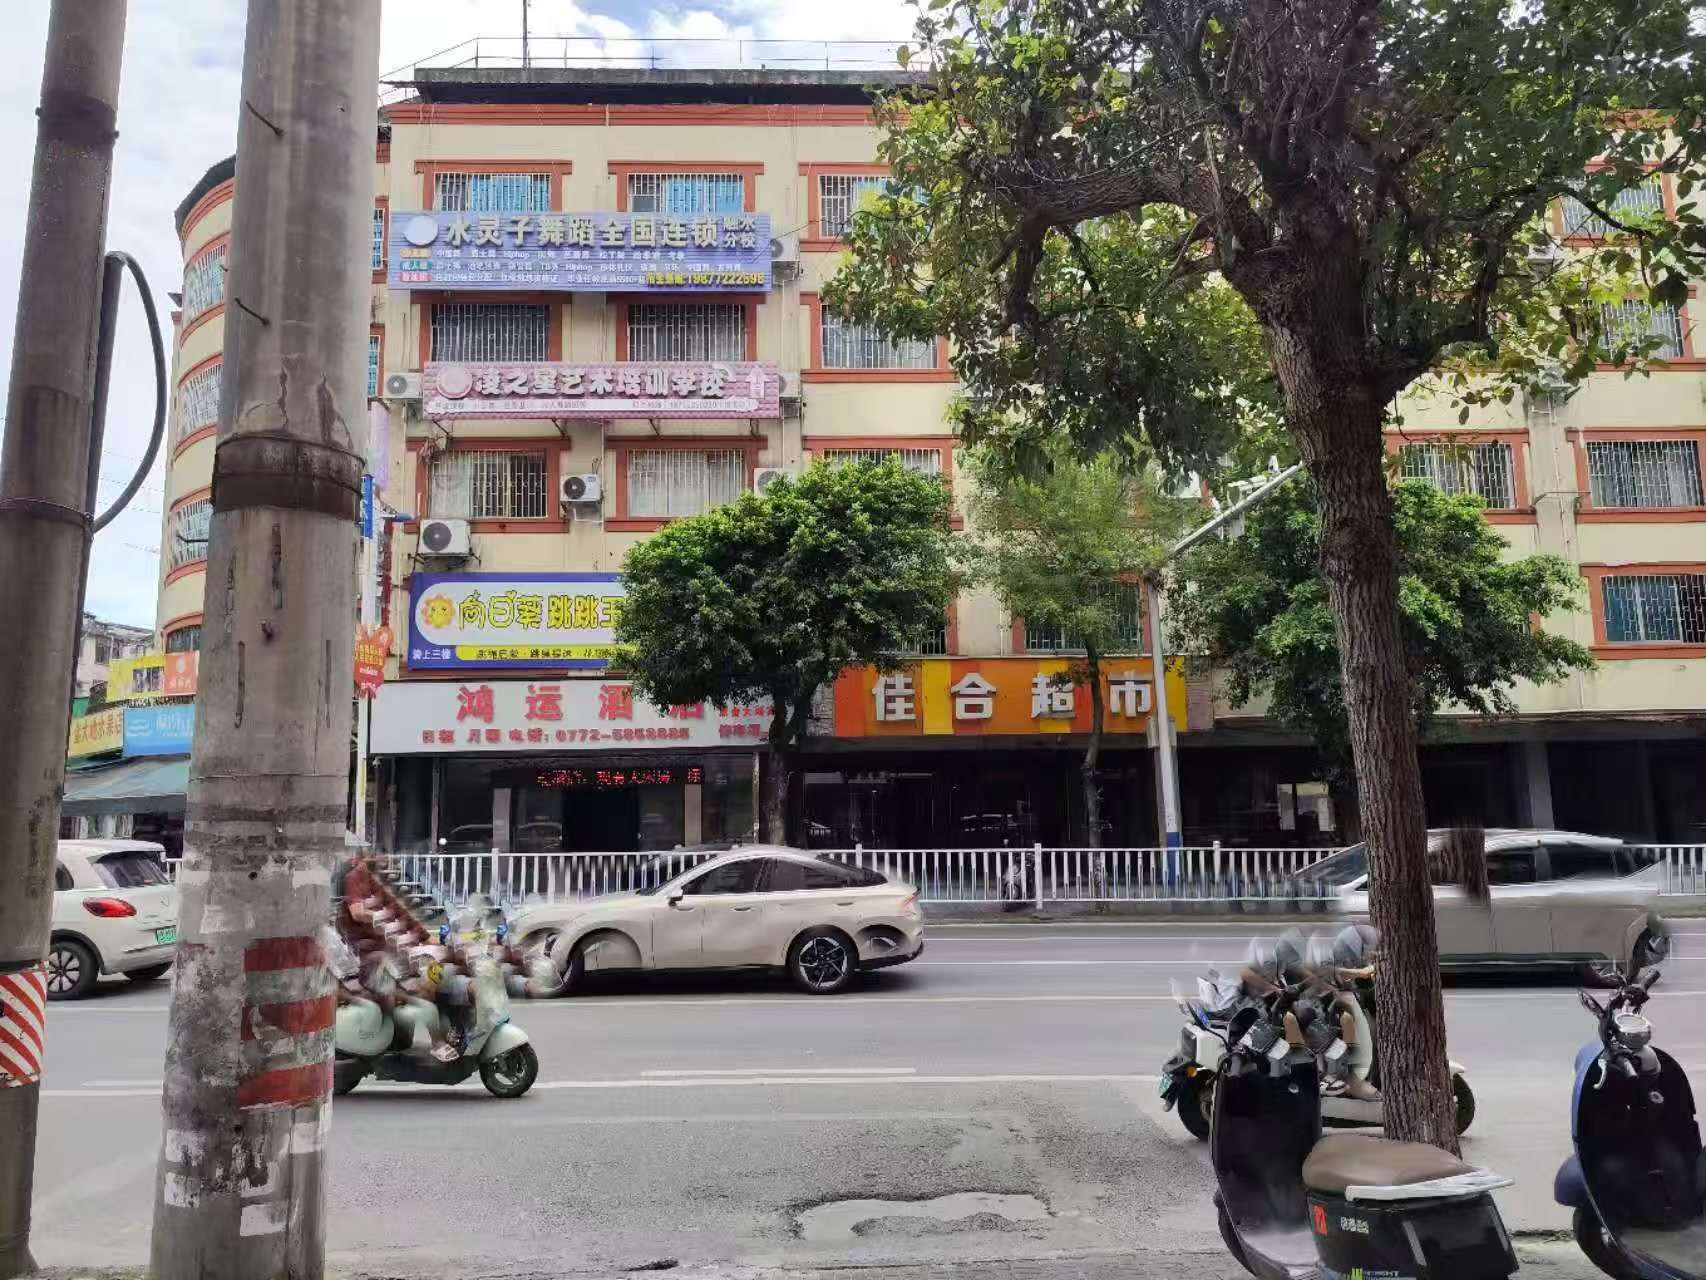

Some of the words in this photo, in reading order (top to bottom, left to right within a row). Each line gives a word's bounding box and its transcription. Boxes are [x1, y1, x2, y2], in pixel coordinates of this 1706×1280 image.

[446, 216, 718, 248] 水灵子舞蹈全国连锁
[872, 671, 1152, 721] 佳合超市
